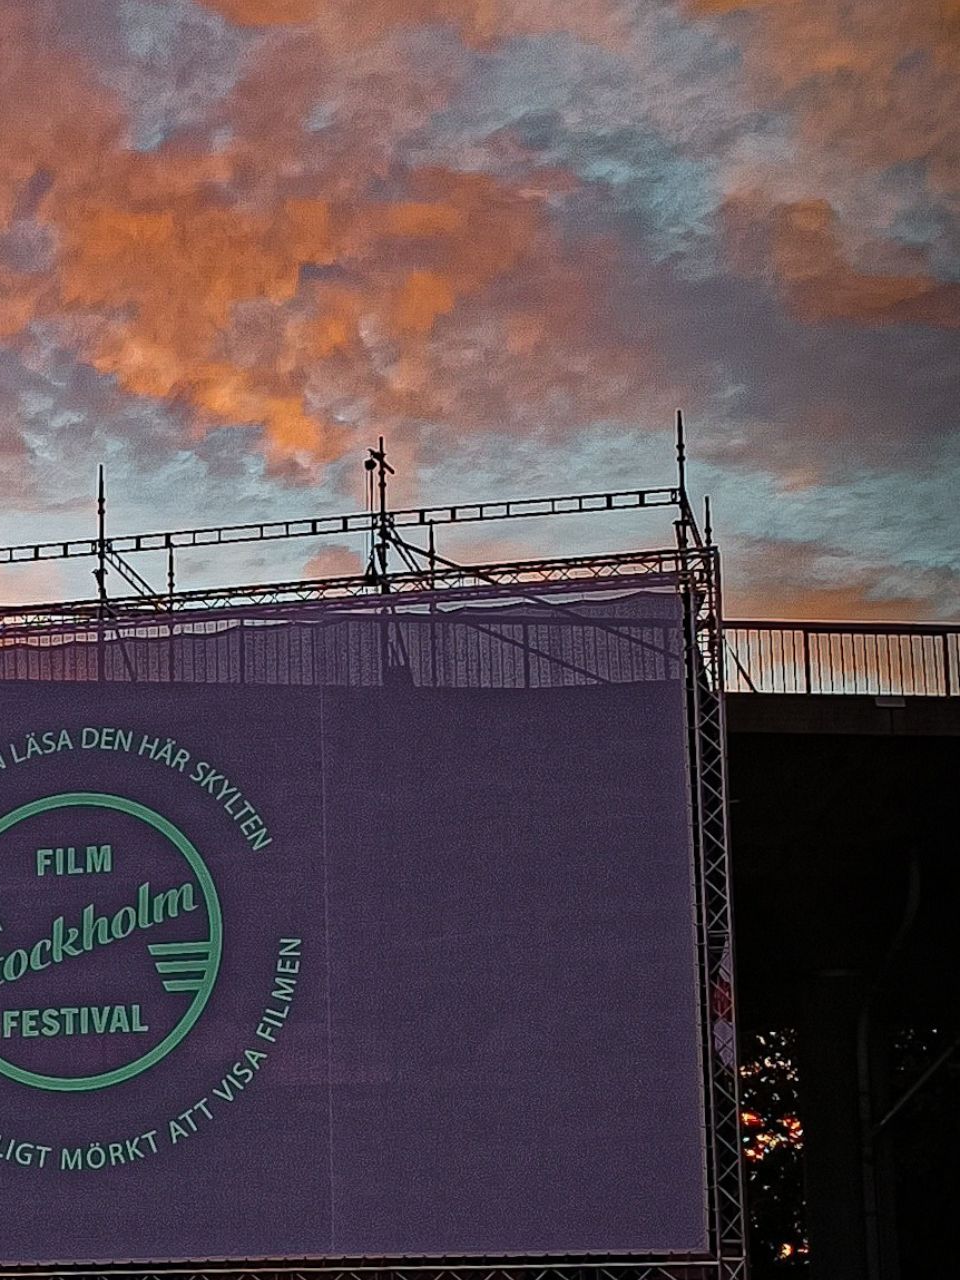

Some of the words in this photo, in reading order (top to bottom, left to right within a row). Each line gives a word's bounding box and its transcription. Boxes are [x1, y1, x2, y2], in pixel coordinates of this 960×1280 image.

[10, 730, 73, 763] LÄSA
[81, 728, 133, 751] DEN
[138, 735, 190, 771] HÄR
[190, 762, 272, 851] SKYLTEN
[36, 845, 112, 876] FILM
[3, 1004, 148, 1037] FESTIVAL
[60, 1130, 158, 1170] MÖRKT
[168, 1099, 215, 1143] ATT
[212, 1048, 268, 1103] VISA
[256, 938, 302, 1043] FILMEN
